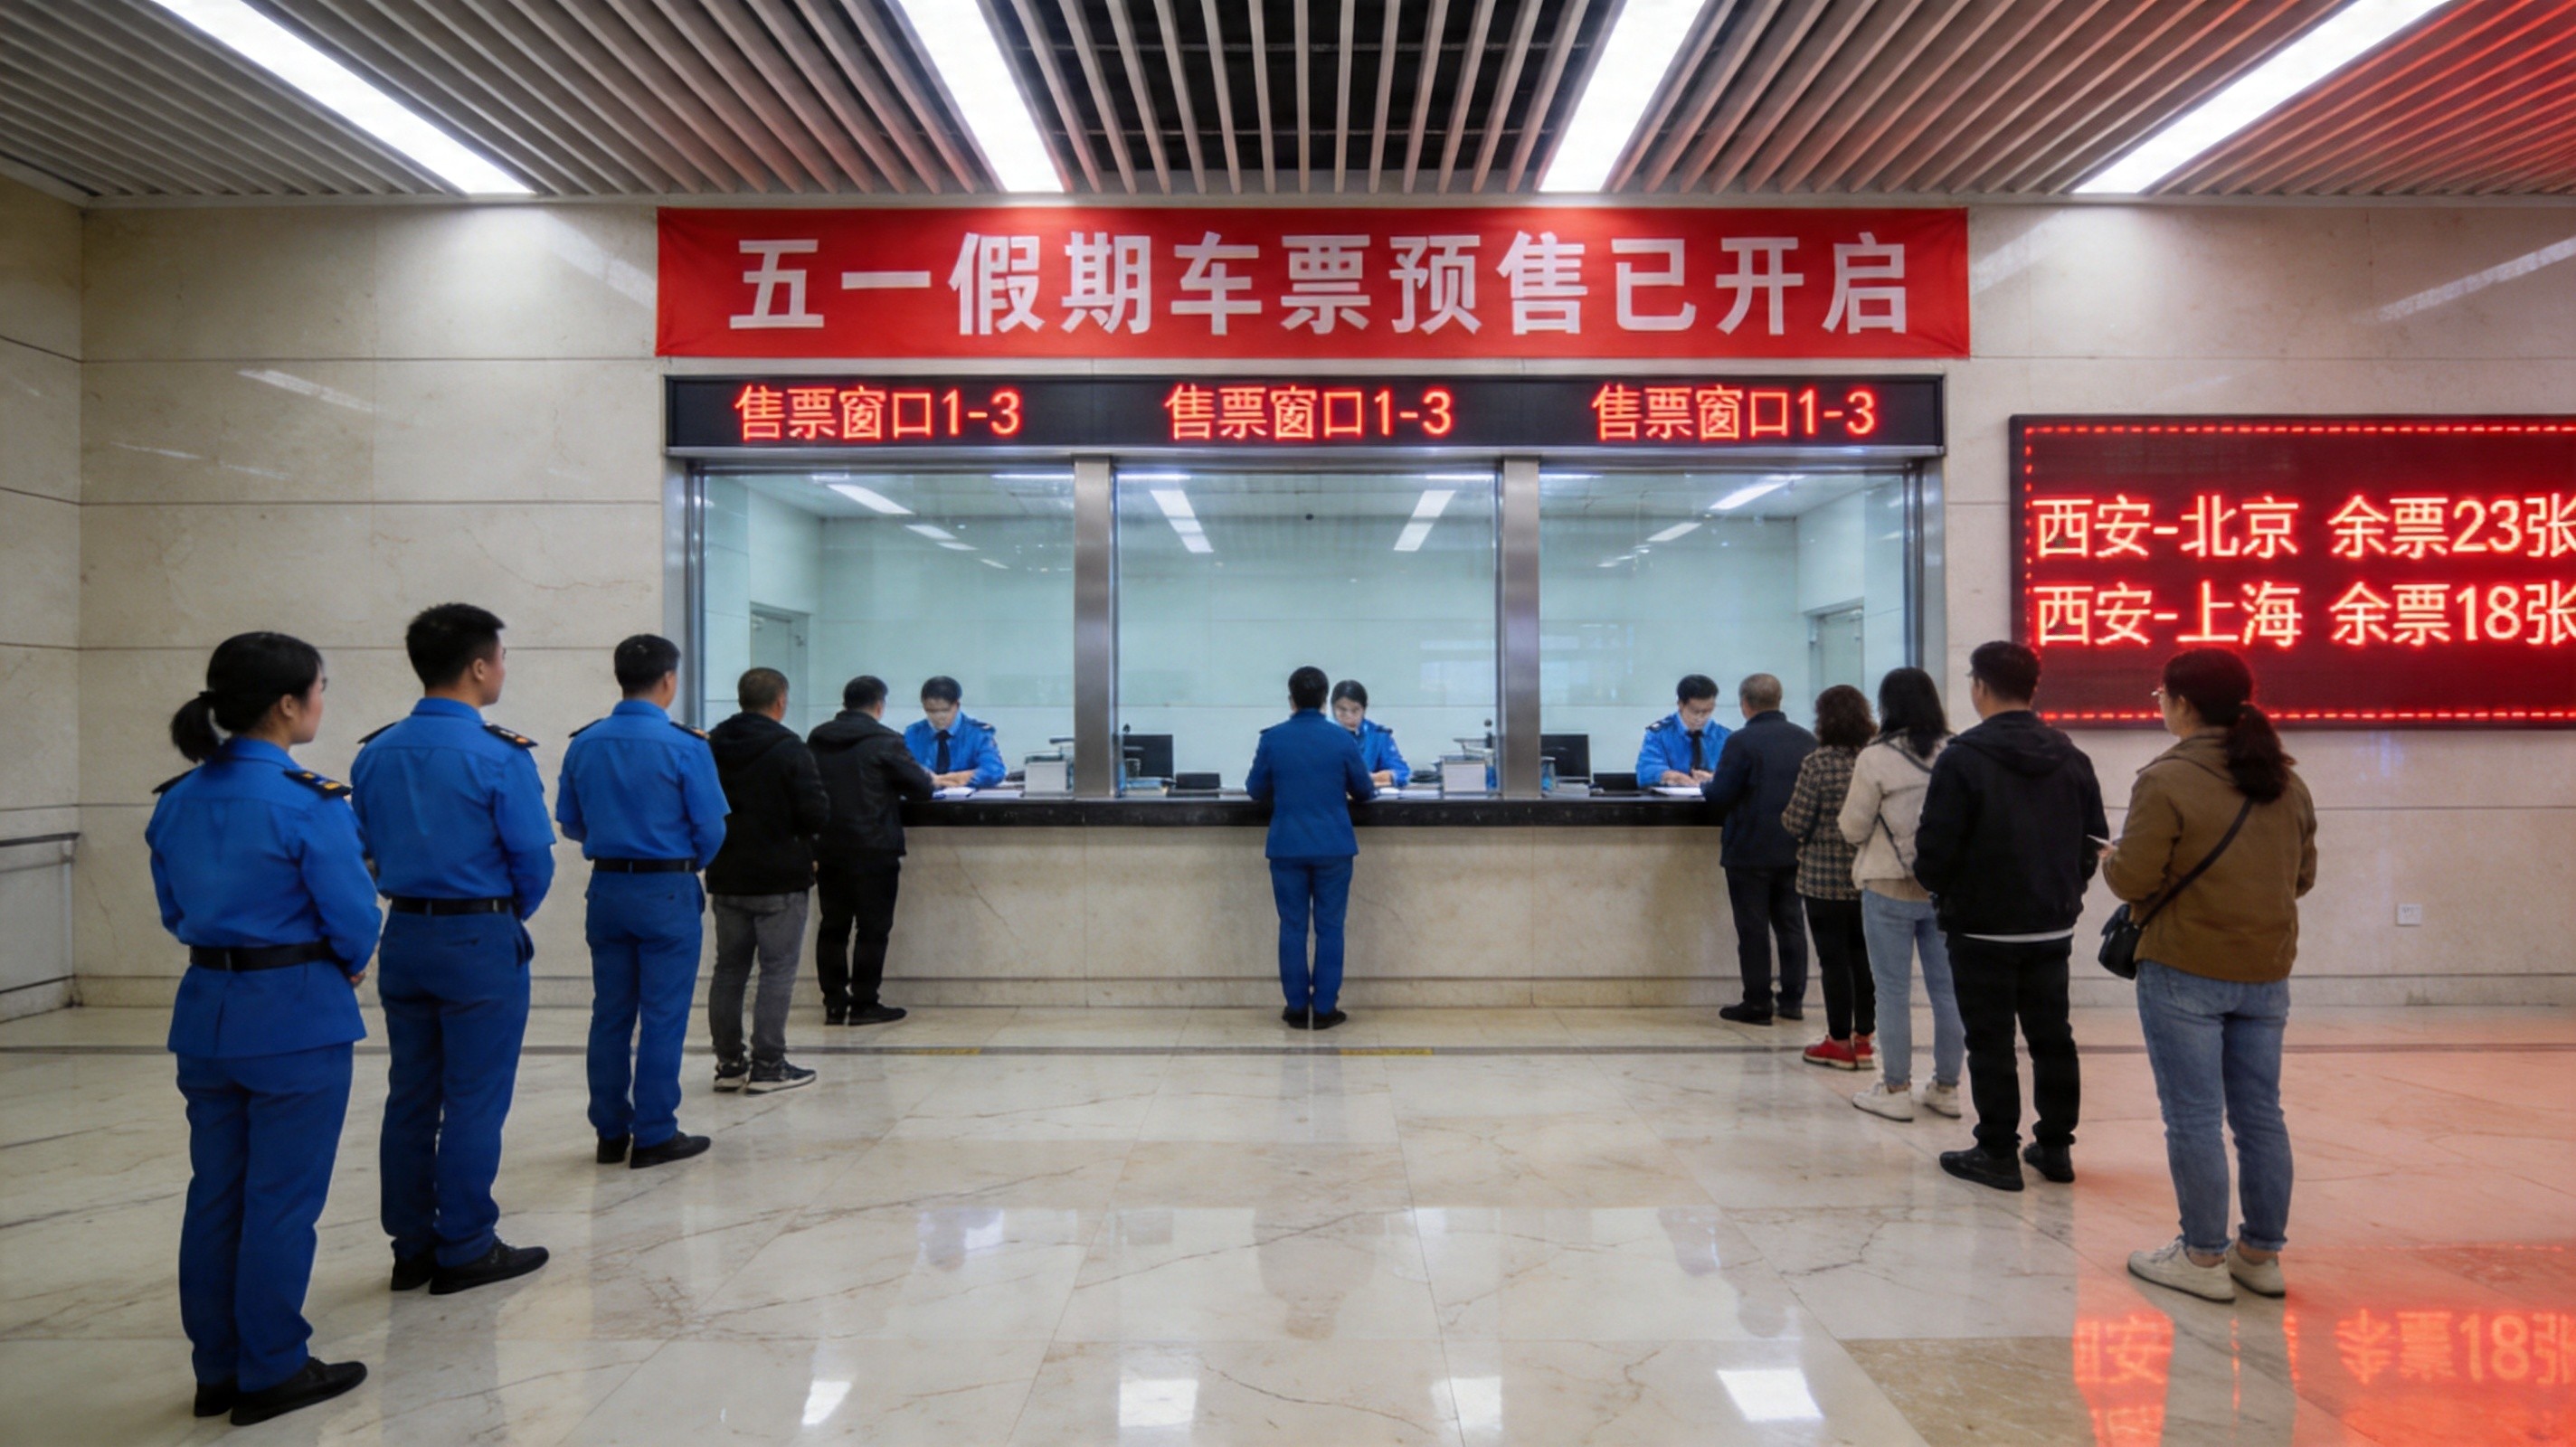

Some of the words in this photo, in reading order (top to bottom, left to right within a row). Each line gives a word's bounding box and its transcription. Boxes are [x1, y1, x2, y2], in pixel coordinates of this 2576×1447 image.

[729, 231, 1908, 337] 五一假期车票预售已开启
[734, 384, 1022, 442] 售票窗口1-3
[1164, 384, 1454, 442] 售票窗口1-3
[1592, 384, 1878, 442] 售票窗口1-3
[2031, 494, 2300, 560] 西安-北京
[2327, 493, 2576, 560] 余票23张
[2033, 581, 2304, 648] 西安-上海
[2329, 580, 2576, 648] 余票18张
